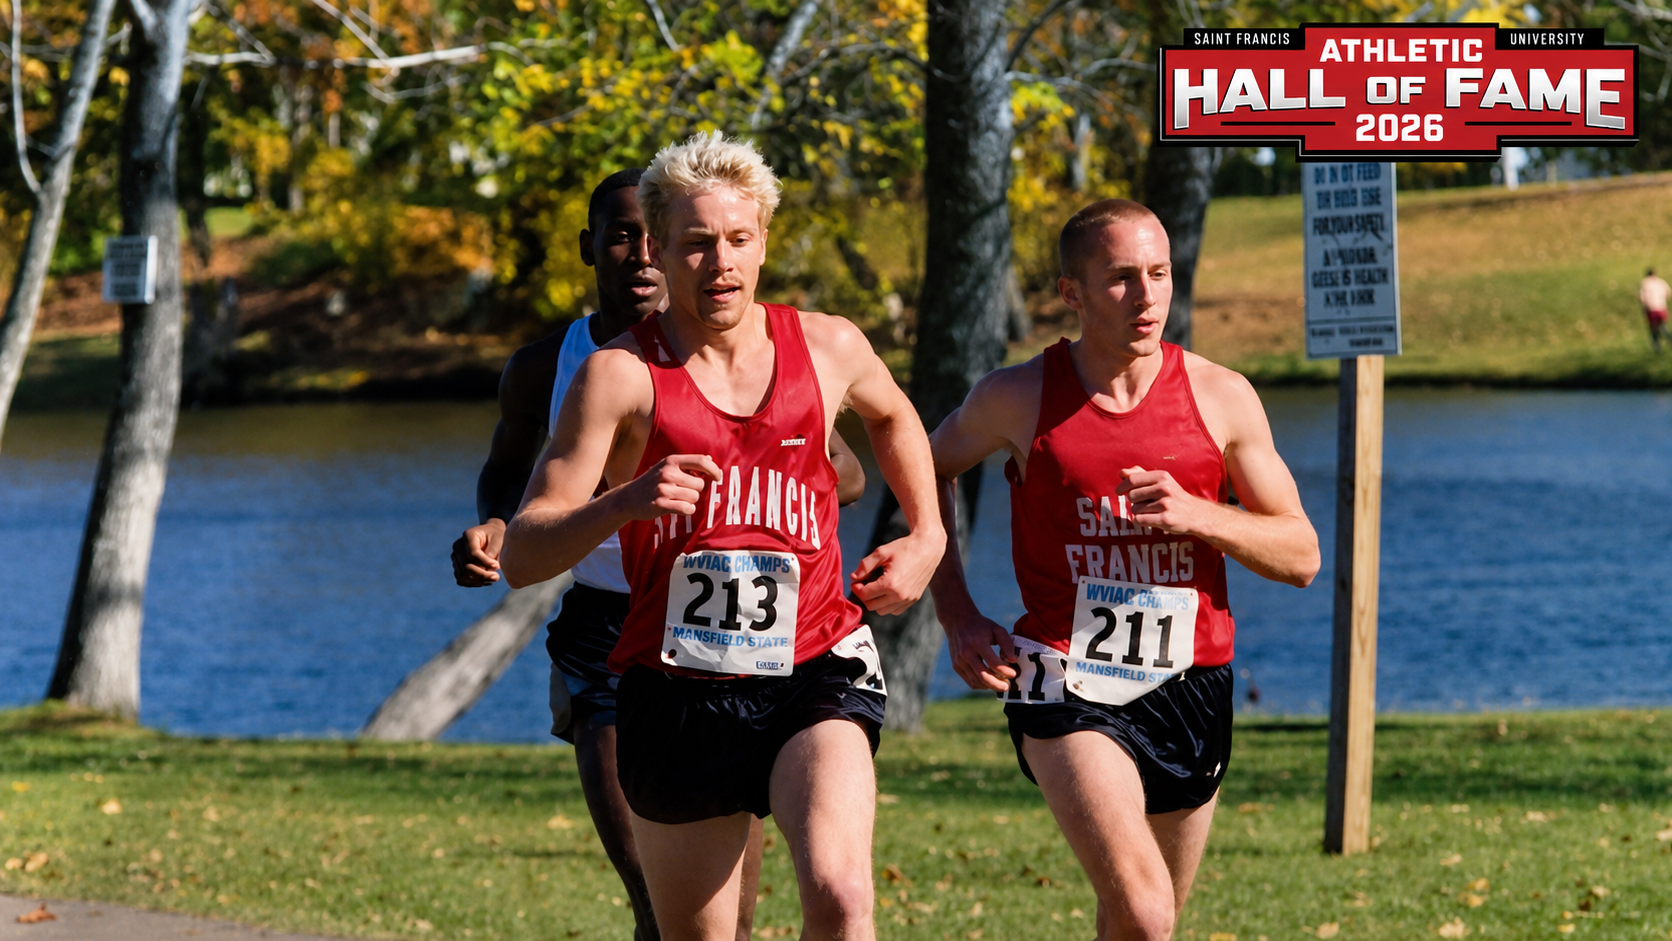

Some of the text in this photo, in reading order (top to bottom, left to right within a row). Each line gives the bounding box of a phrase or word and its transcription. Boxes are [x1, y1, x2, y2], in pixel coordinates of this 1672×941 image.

[1356, 162, 1381, 181] FEED
[706, 465, 821, 550] FRANCIS
[683, 555, 791, 574] WVIAC CHAMPS
[1065, 541, 1194, 584] FRANCIS
[682, 572, 779, 632] 213
[1086, 583, 1189, 610] WVIAC CHAMPS
[673, 626, 788, 648] MANSFIELD STATE
[1085, 606, 1174, 669] 211
[1075, 661, 1146, 682] MANSFIELD
